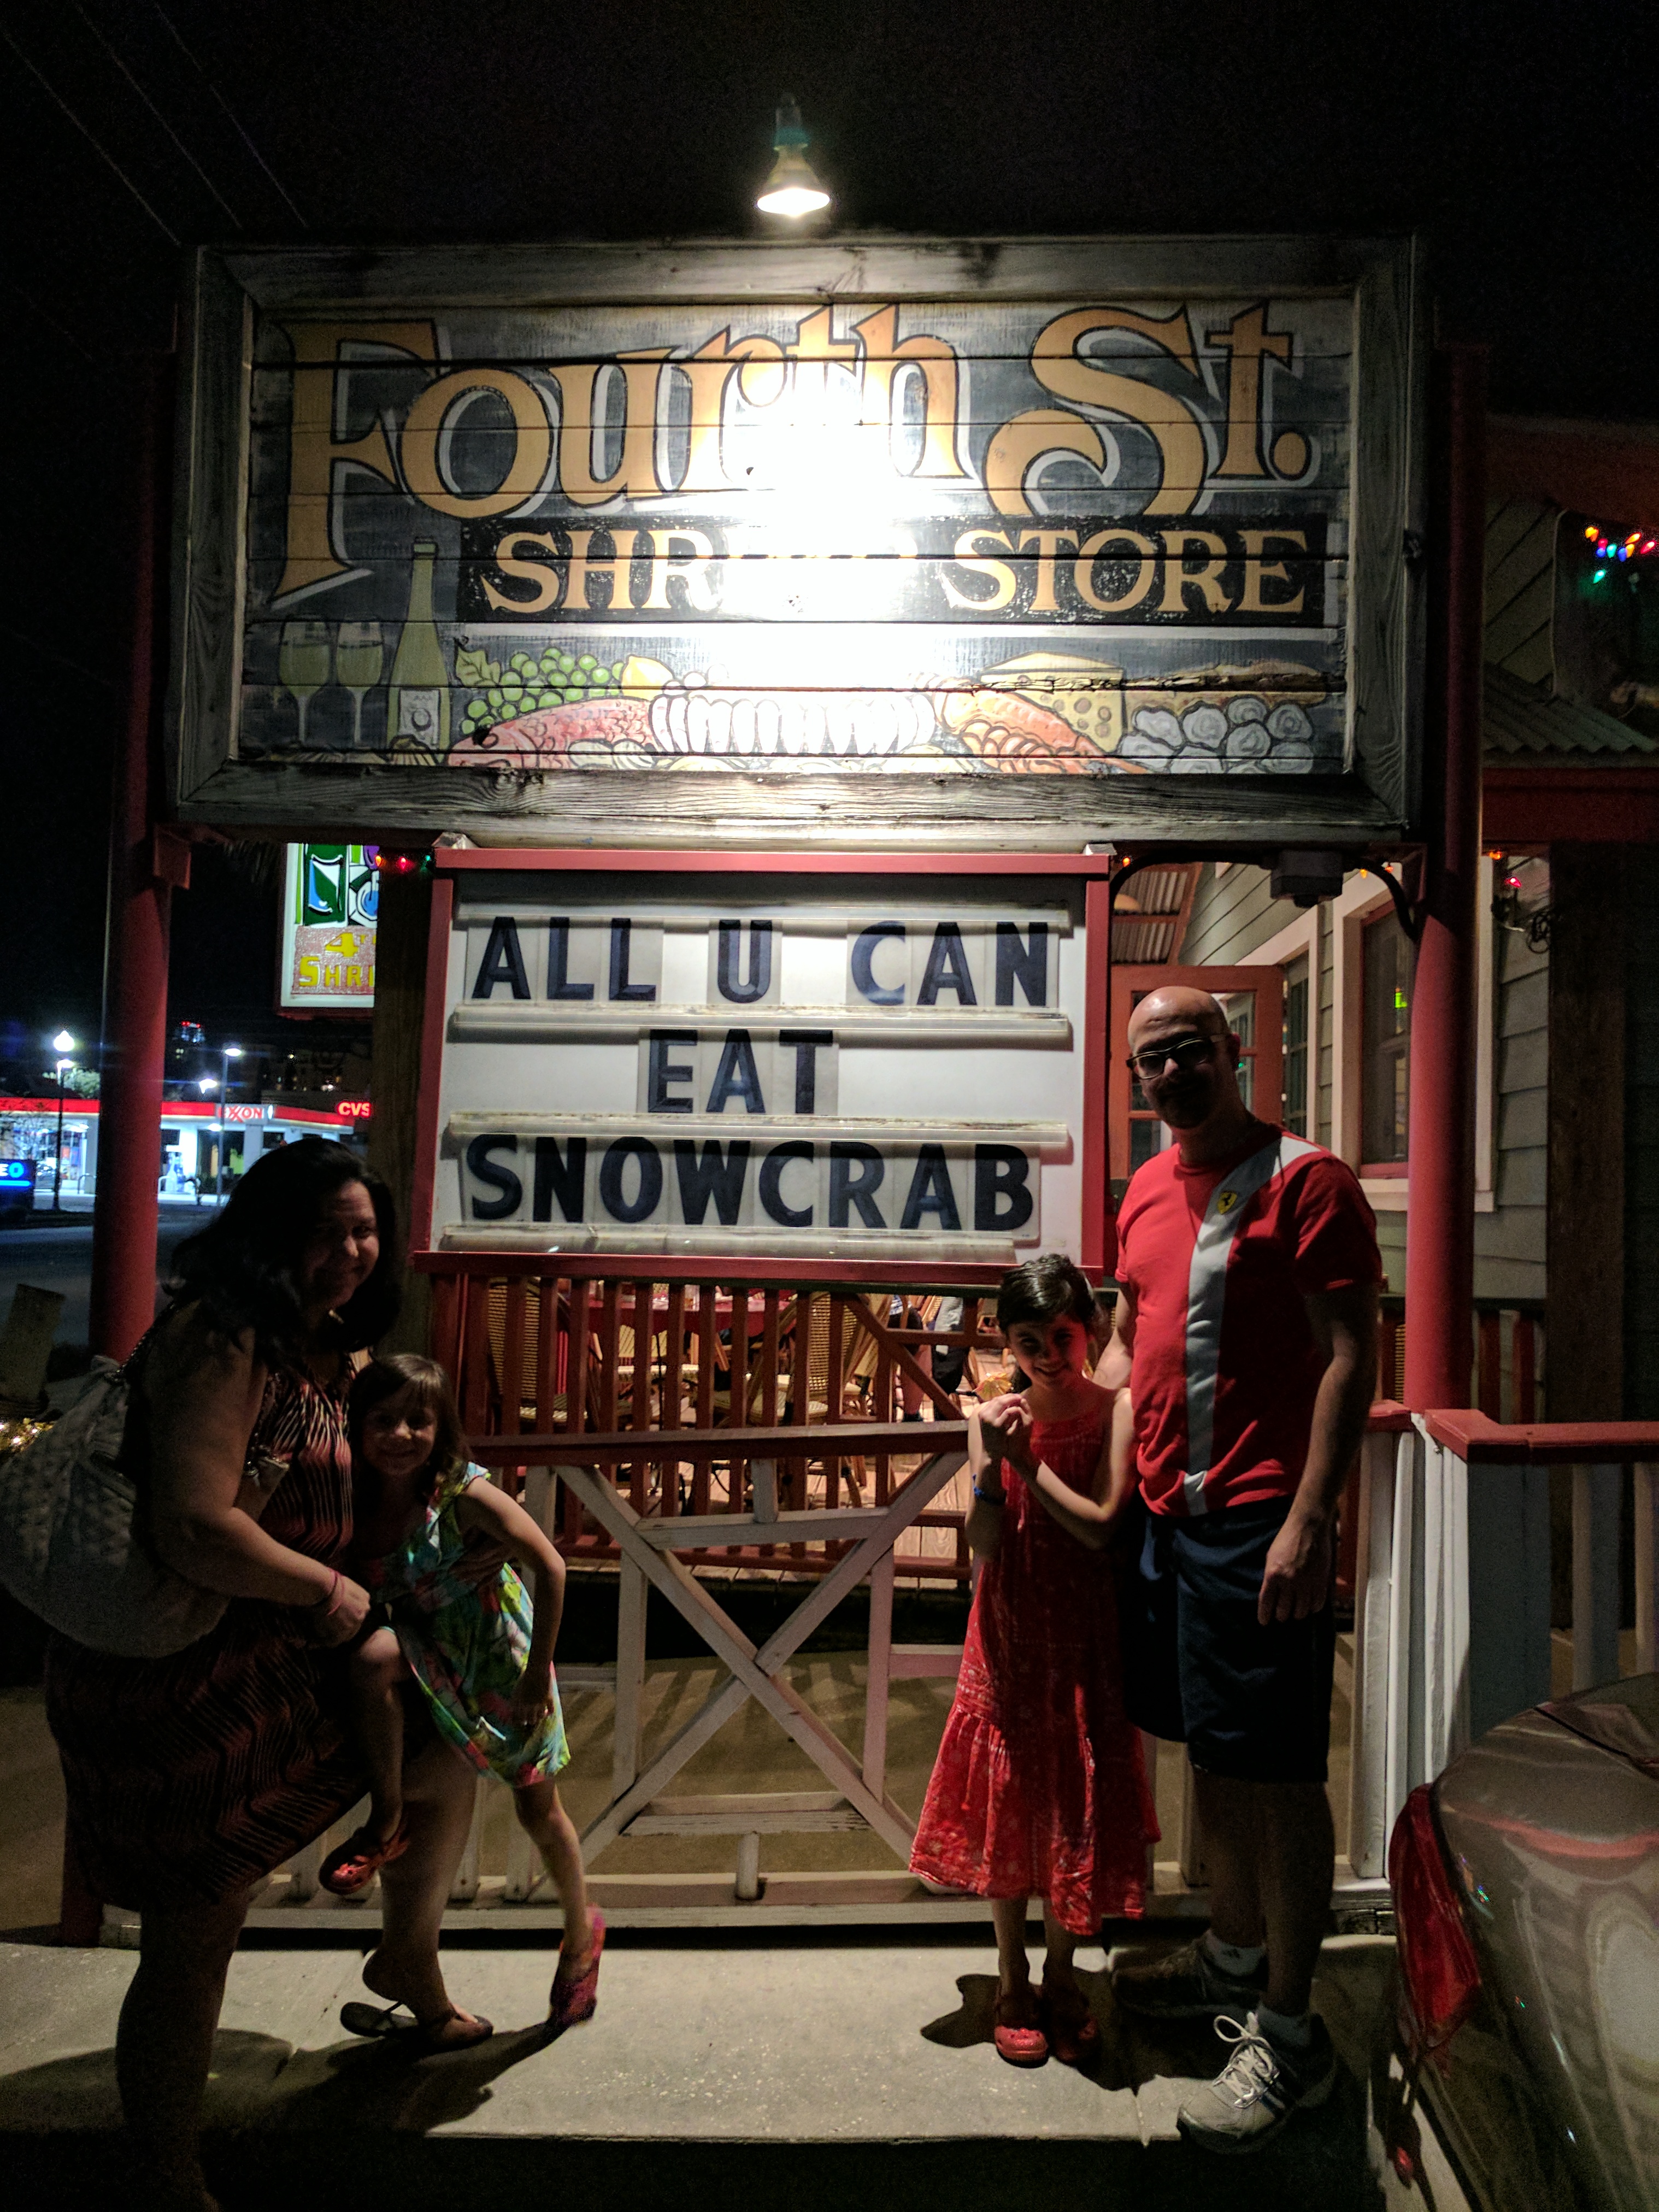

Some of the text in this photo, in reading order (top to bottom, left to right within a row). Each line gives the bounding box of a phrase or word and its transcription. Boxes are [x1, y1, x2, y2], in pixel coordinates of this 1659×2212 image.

[271, 299, 1310, 599] Fourth St.
[938, 527, 1307, 614] STORE
[471, 916, 1049, 1007] ALL U CAN
[338, 1101, 370, 1117] CVS
[647, 1029, 834, 1114] EAT
[466, 1133, 1033, 1231] SNOWCRAB
